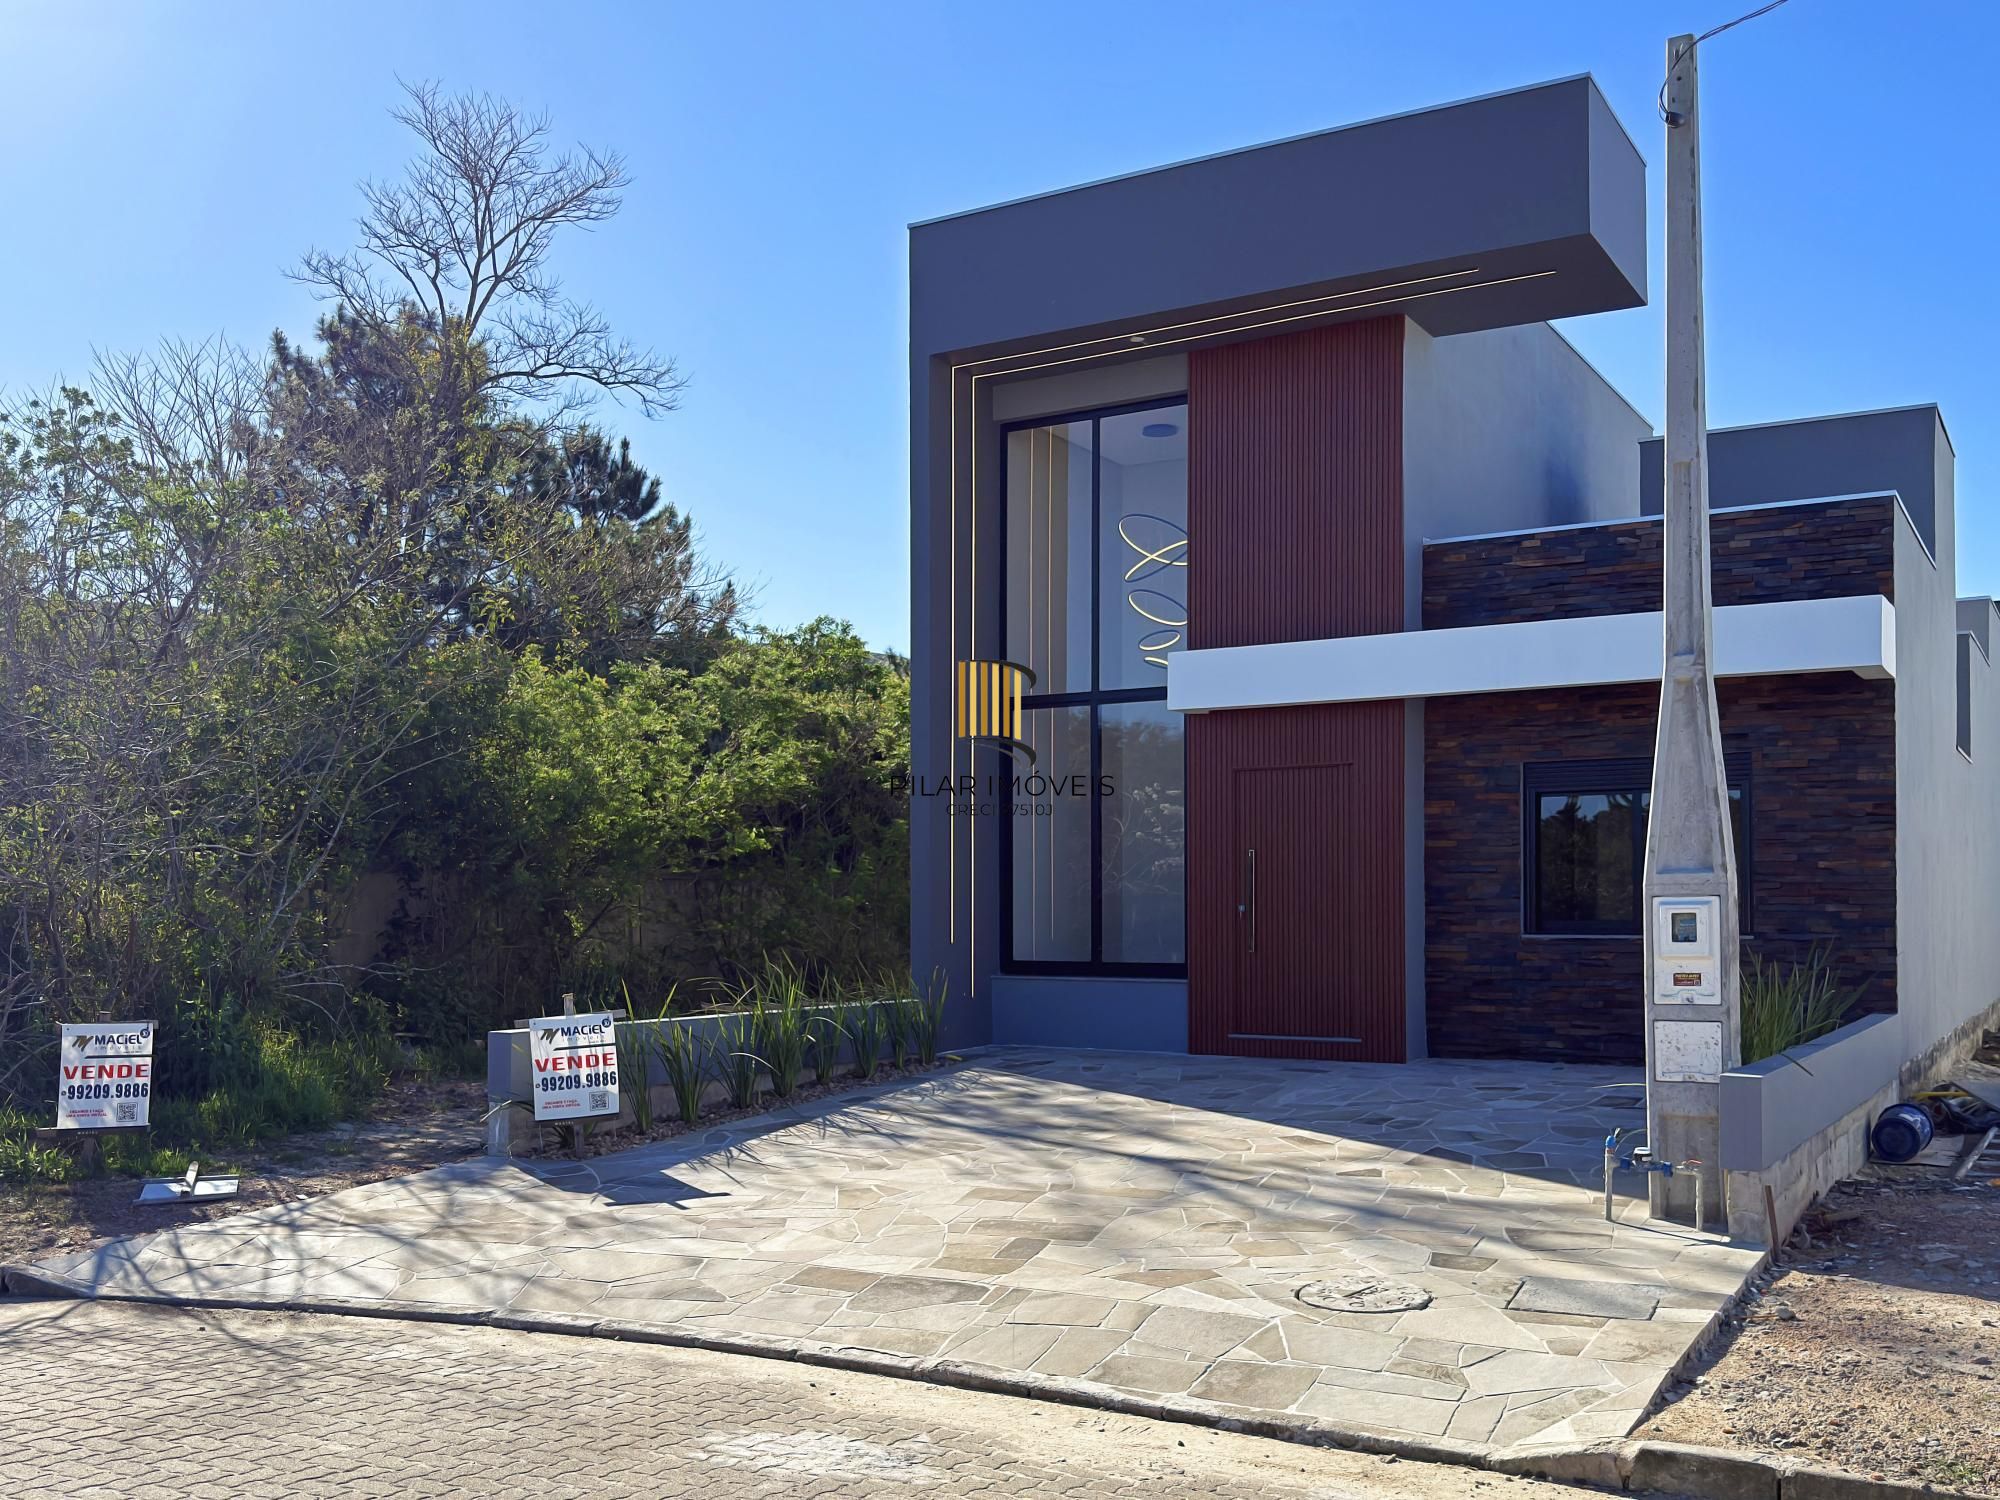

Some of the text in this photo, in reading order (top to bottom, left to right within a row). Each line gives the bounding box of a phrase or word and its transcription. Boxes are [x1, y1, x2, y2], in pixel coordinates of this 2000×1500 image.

[64, 1064, 149, 1079] VENDE
[535, 1053, 615, 1072] VENDE
[541, 1071, 617, 1092] 99209.9886
[67, 1083, 149, 1100] 99209.9886
